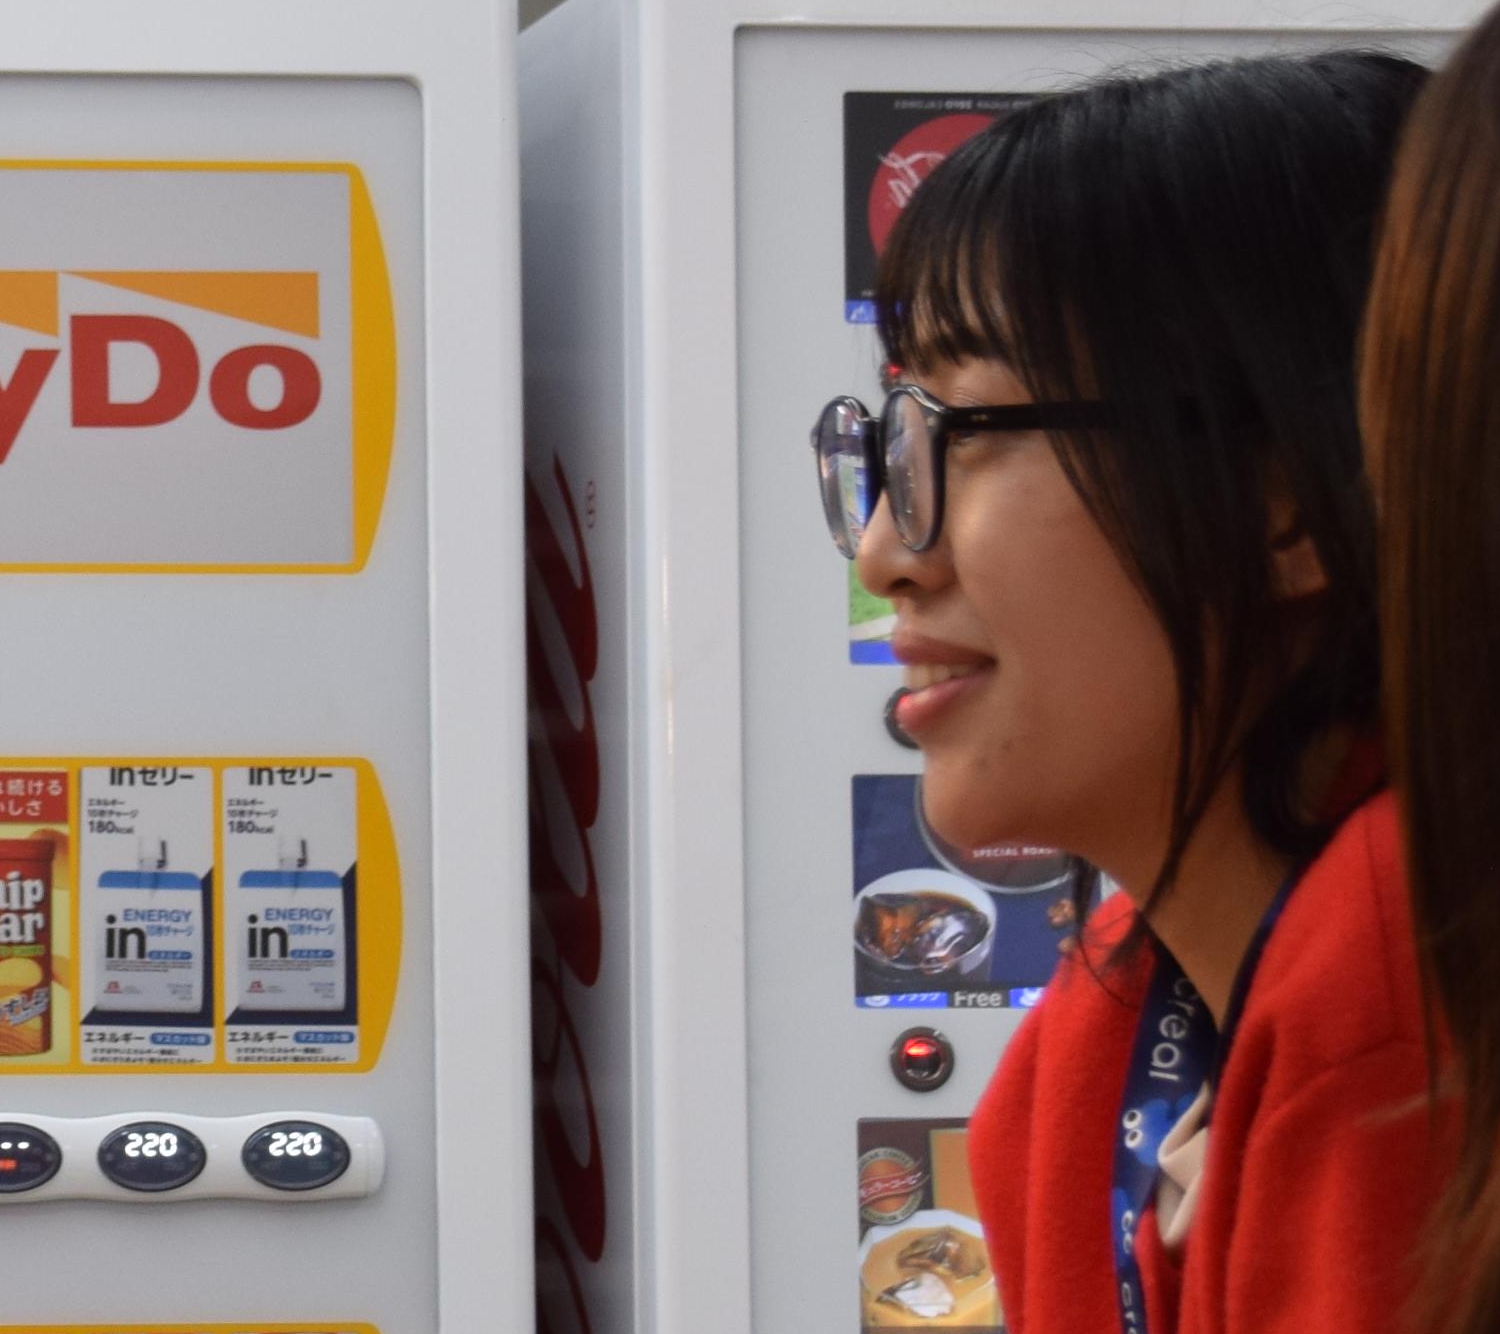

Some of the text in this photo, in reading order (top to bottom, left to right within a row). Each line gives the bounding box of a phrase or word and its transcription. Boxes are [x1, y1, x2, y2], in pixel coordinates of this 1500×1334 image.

[972, 847, 1018, 858] SPECIAL
[123, 908, 193, 923] ENERGY
[264, 907, 334, 921] ENERGY
[105, 914, 146, 959] in
[247, 914, 288, 959] in
[954, 990, 1001, 1007] Free
[84, 1032, 145, 1043] エネルギー
[227, 1031, 289, 1043] エネルギー
[124, 1132, 178, 1158] 220
[268, 1131, 322, 1157] 220
